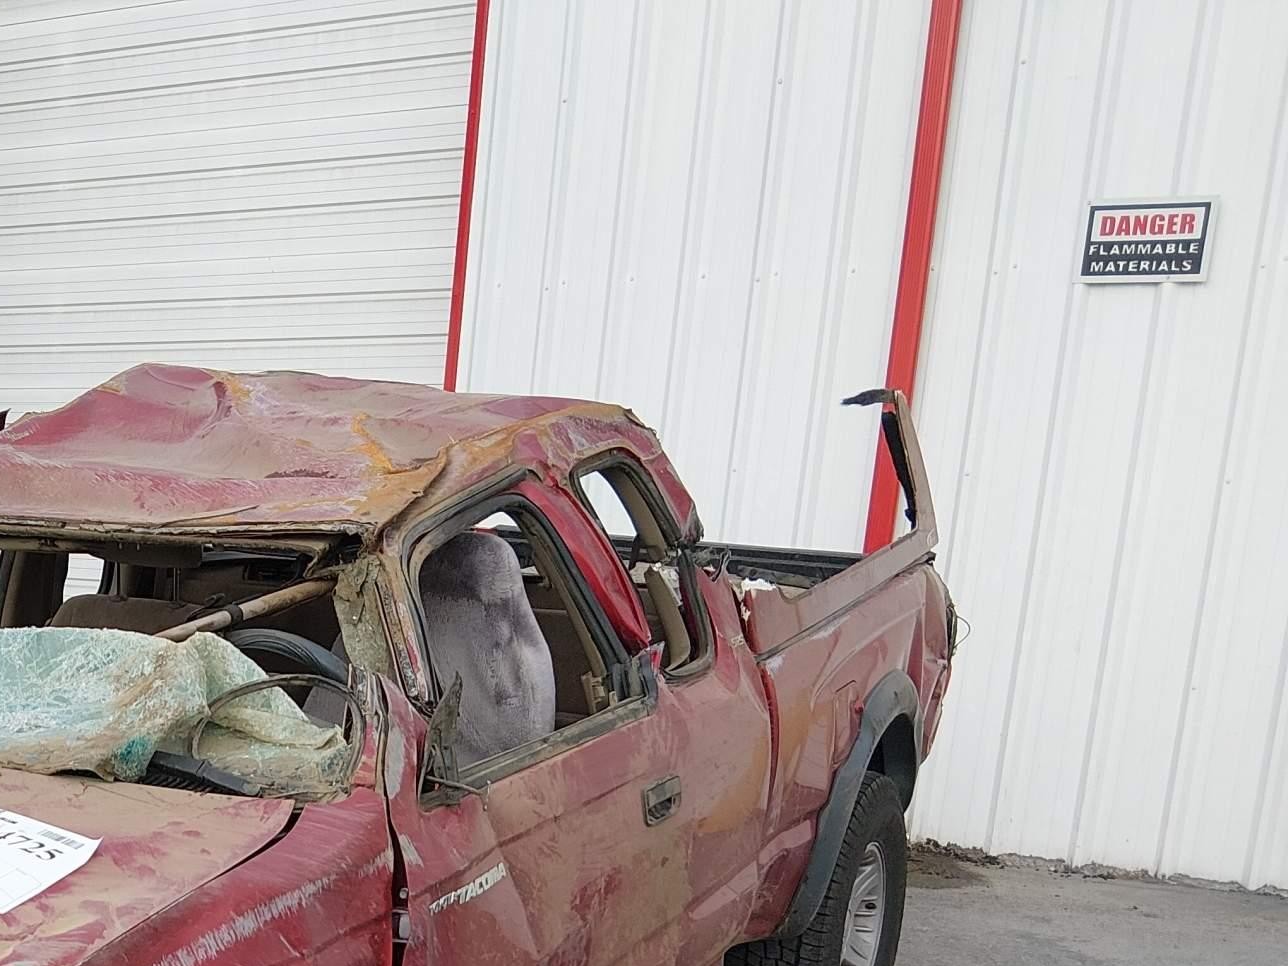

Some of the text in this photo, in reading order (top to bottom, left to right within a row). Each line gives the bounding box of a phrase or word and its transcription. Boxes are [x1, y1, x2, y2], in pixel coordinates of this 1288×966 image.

[1099, 213, 1196, 236] DANGER
[1088, 242, 1200, 256] FLAMMABLE
[1089, 259, 1193, 273] MATERIALS
